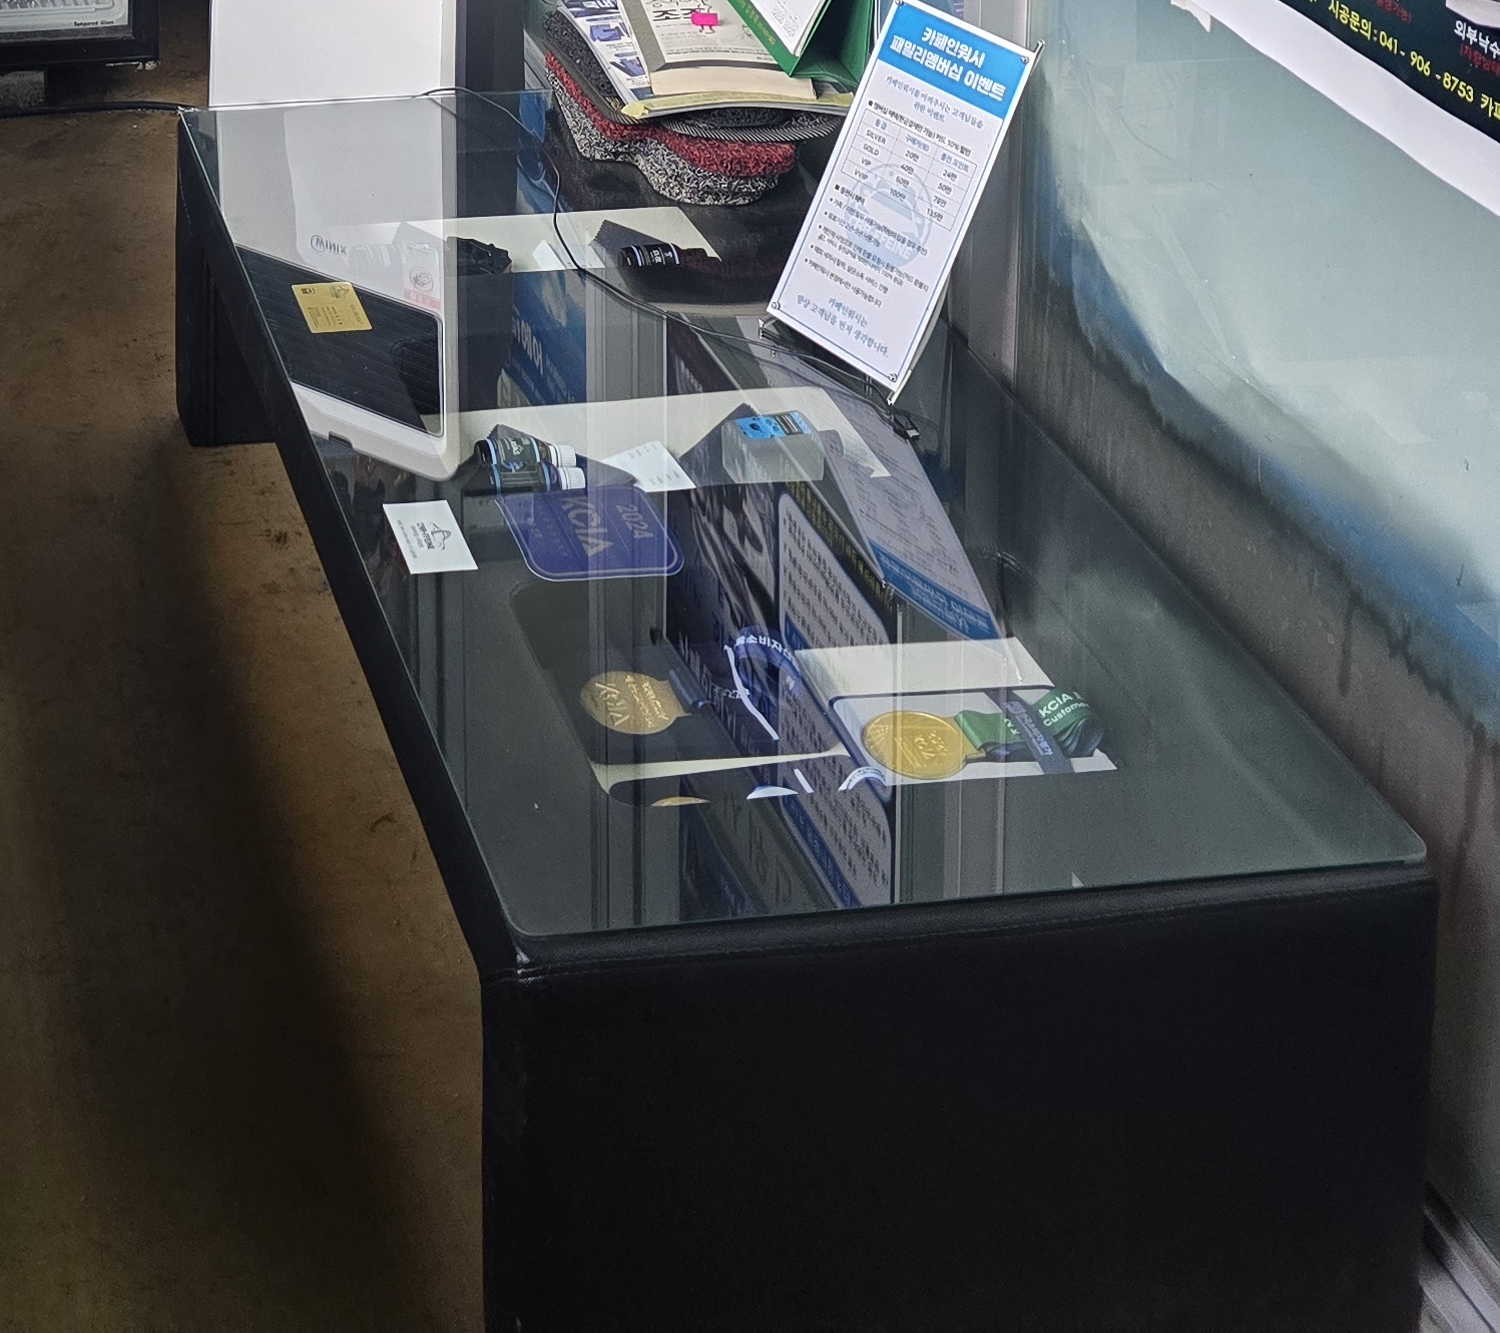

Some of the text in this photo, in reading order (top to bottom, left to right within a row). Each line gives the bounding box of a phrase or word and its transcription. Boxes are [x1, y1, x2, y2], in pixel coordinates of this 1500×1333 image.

[922, 27, 985, 68] 카페인워시
[890, 35, 1006, 101] 패밀리멤버십 이벤트
[863, 143, 879, 156] GOLD
[616, 504, 654, 539] 2024
[1039, 693, 1073, 718] KCIA
